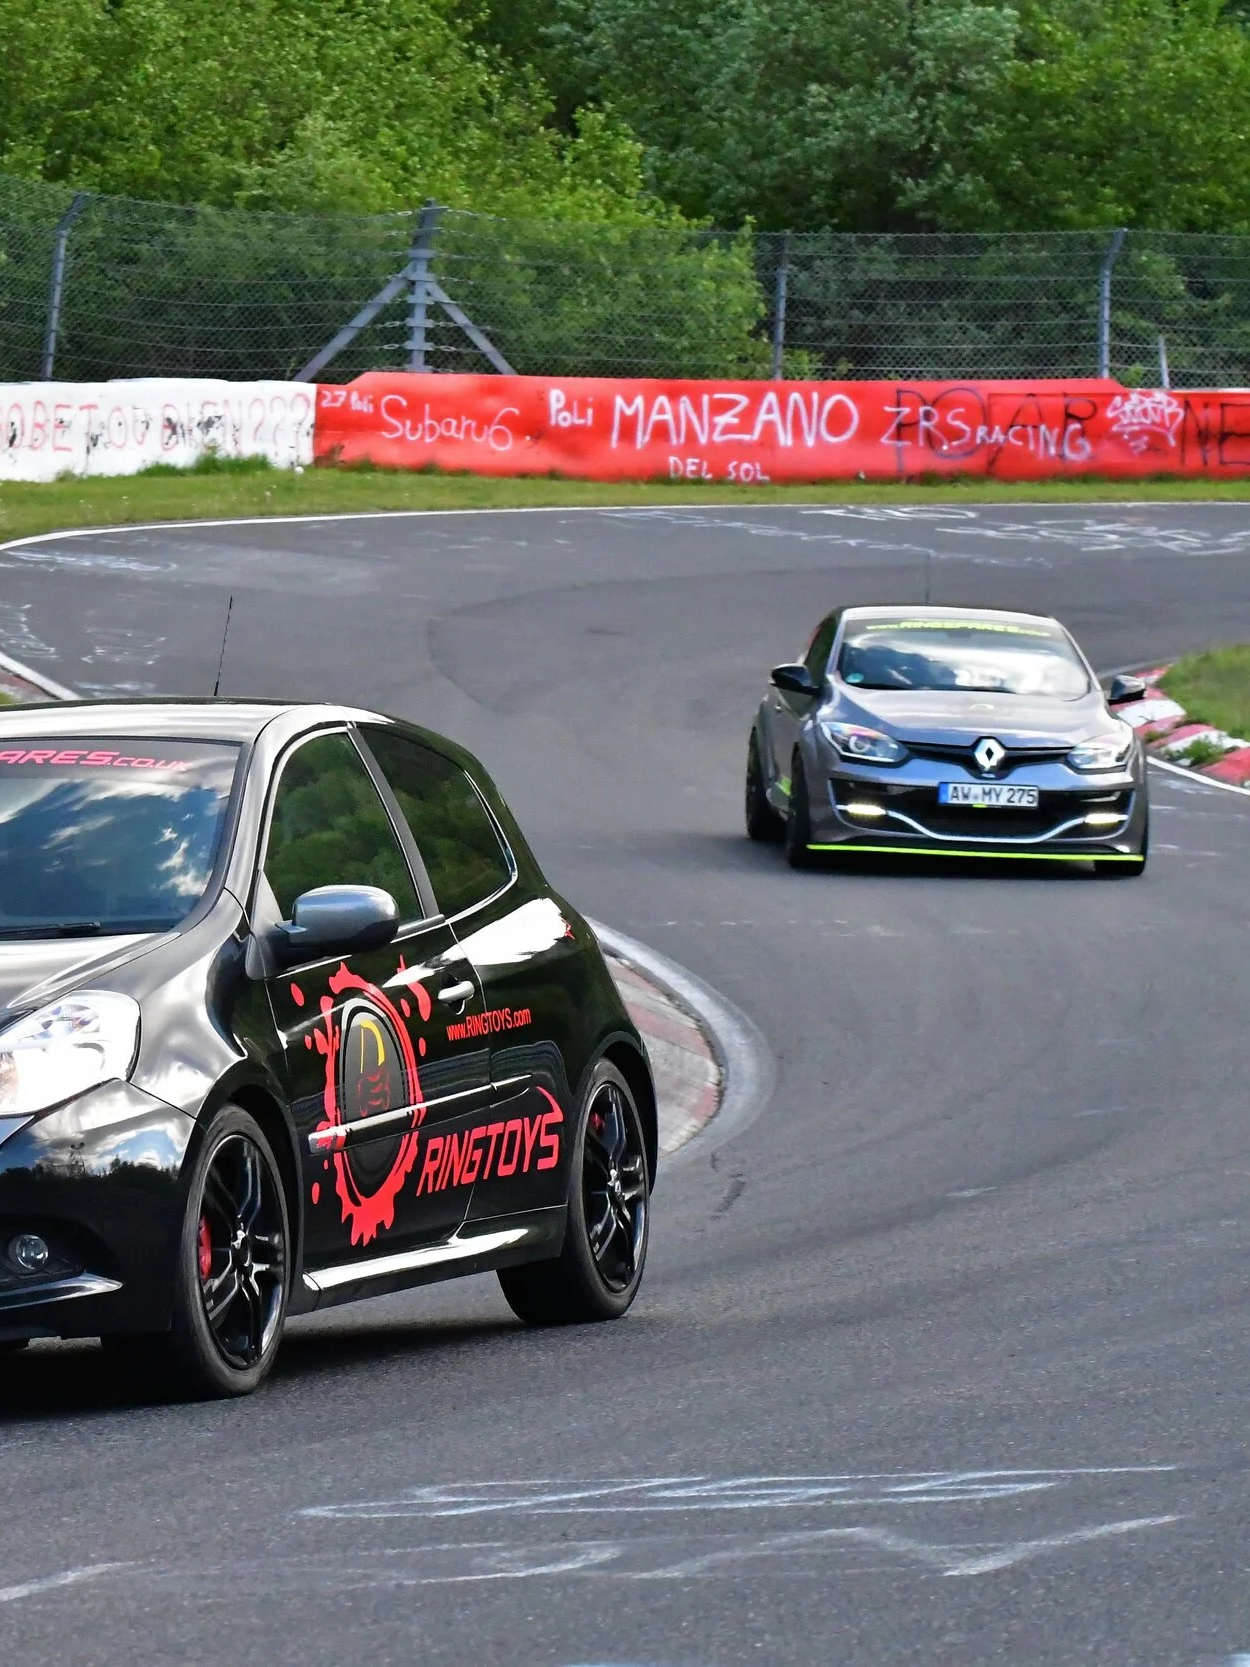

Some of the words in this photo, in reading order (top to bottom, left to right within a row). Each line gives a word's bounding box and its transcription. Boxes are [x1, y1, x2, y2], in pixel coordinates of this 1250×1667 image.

[611, 391, 859, 449] MANZANO
[669, 456, 713, 480] DEL
[726, 460, 770, 482] SOL
[951, 785, 971, 802] AW
[981, 787, 1003, 803] MY
[1006, 788, 1036, 804] 275
[445, 1008, 532, 1042] www.RINGTOYS.com
[416, 1086, 564, 1197] RINGTOYS
